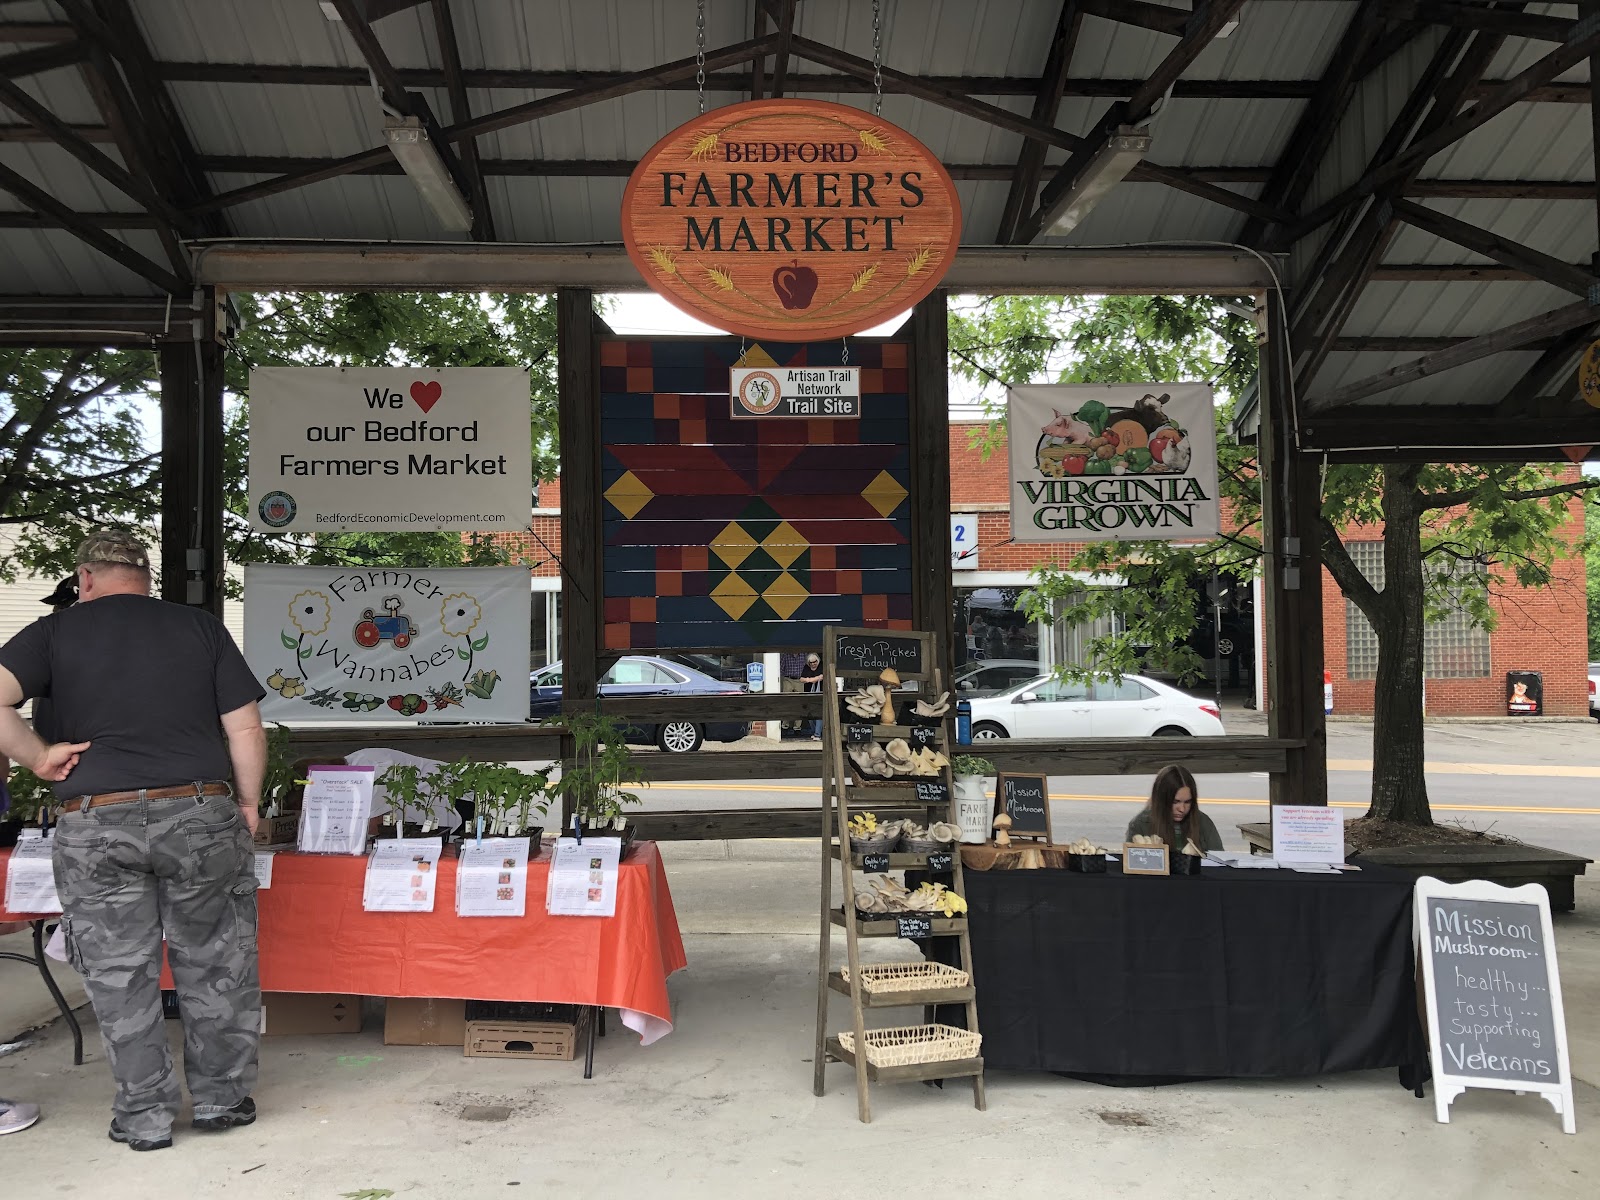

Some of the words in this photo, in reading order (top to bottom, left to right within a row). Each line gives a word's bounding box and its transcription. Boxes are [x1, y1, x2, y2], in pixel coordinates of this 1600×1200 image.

[724, 142, 858, 163] BEDFORD
[659, 171, 924, 208] FARMER'S
[683, 215, 904, 252] MARKET
[787, 370, 825, 382] Artisan
[829, 370, 851, 382] Trail
[363, 388, 404, 410] We
[797, 383, 842, 395] Network
[787, 398, 818, 414] Trail
[823, 398, 852, 414] Site
[306, 426, 355, 442] our
[364, 420, 478, 442] Bedford
[280, 454, 399, 476] Farmers
[408, 454, 507, 476] Market
[1017, 478, 1211, 507] VIRGINIA
[316, 512, 506, 526] BedfordEconomicDevelopment.com
[1033, 503, 1196, 532] GROWN
[955, 525, 965, 542] 2
[328, 570, 444, 602] Farmer
[836, 636, 872, 658] Fresh
[873, 641, 917, 658] Picked
[316, 639, 455, 683] Wannabes
[1005, 780, 1042, 801] Mission
[1006, 798, 1045, 820] Mushroom
[1435, 907, 1537, 943] Mission
[1449, 1018, 1541, 1048] Supporting
[1446, 1043, 1552, 1076] Veterans
